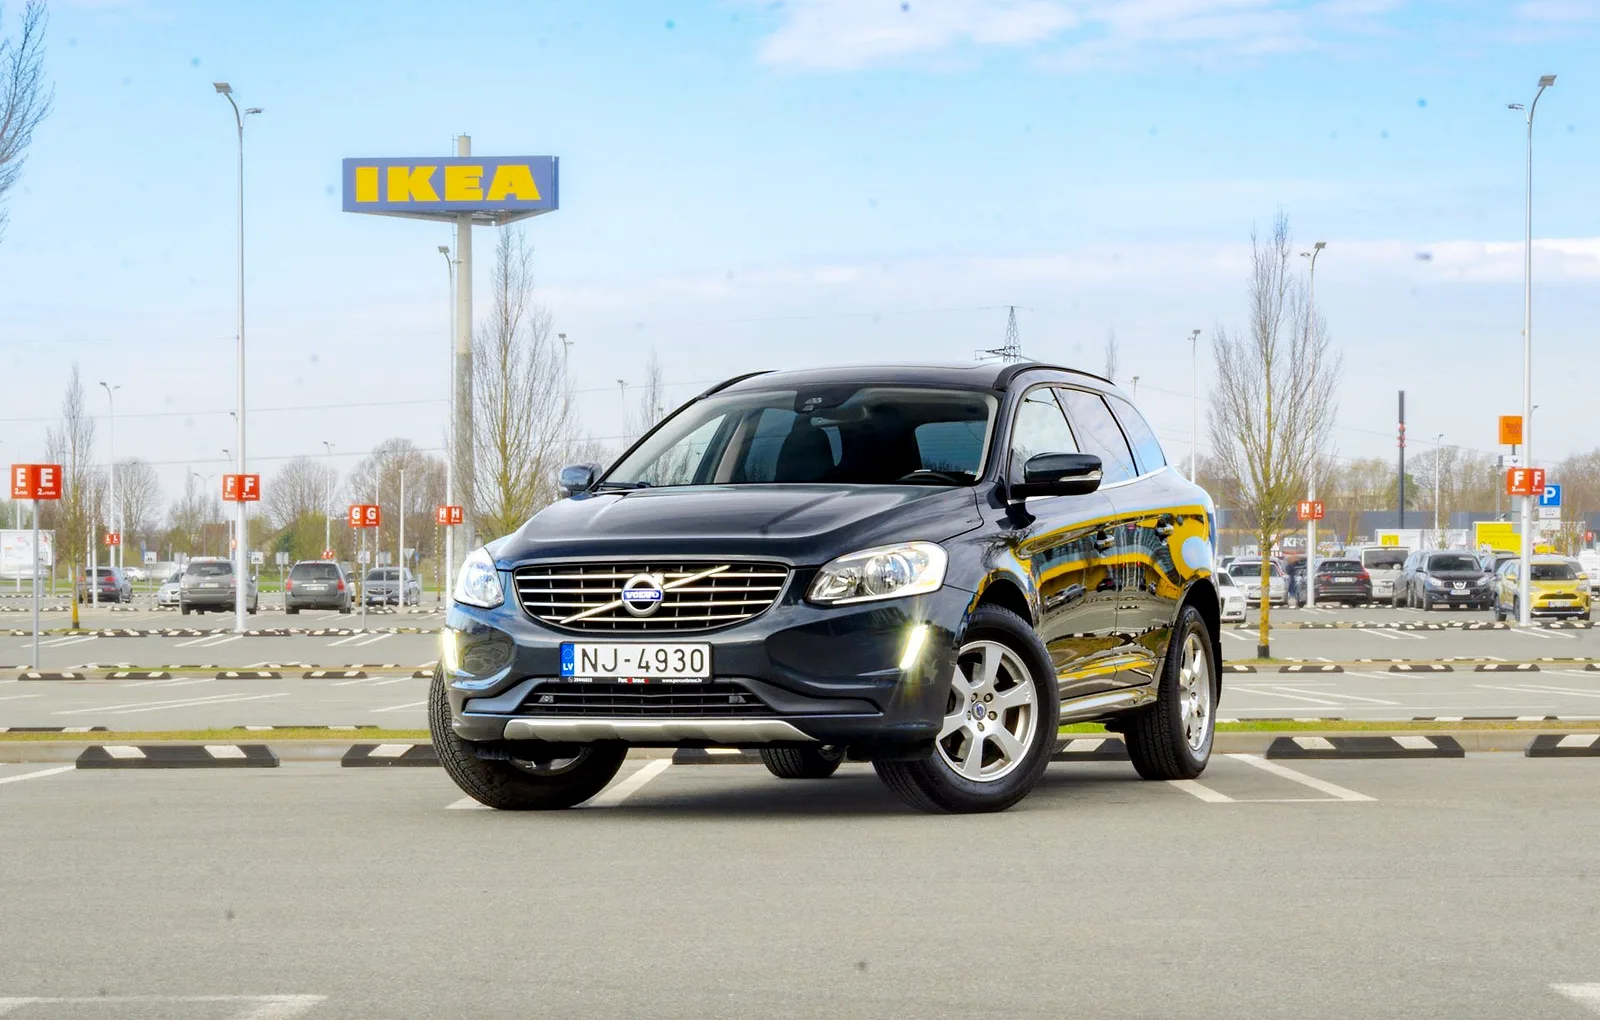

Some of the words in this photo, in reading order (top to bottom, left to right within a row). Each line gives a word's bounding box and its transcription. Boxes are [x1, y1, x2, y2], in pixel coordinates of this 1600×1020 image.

[355, 165, 542, 202] IKEA
[16, 467, 26, 487] E
[40, 468, 53, 487] E
[227, 477, 235, 492] F
[244, 477, 254, 492] F
[1514, 471, 1524, 486] F
[1534, 471, 1541, 486] F
[1543, 486, 1556, 504] P
[351, 506, 361, 520] G
[366, 507, 377, 520] G
[440, 507, 447, 518] H
[451, 507, 460, 518] H
[1301, 502, 1310, 513] H
[1314, 503, 1322, 513] H
[624, 590, 660, 599] VOLVO
[562, 663, 574, 671] LV
[581, 647, 704, 673] NJ-4930
